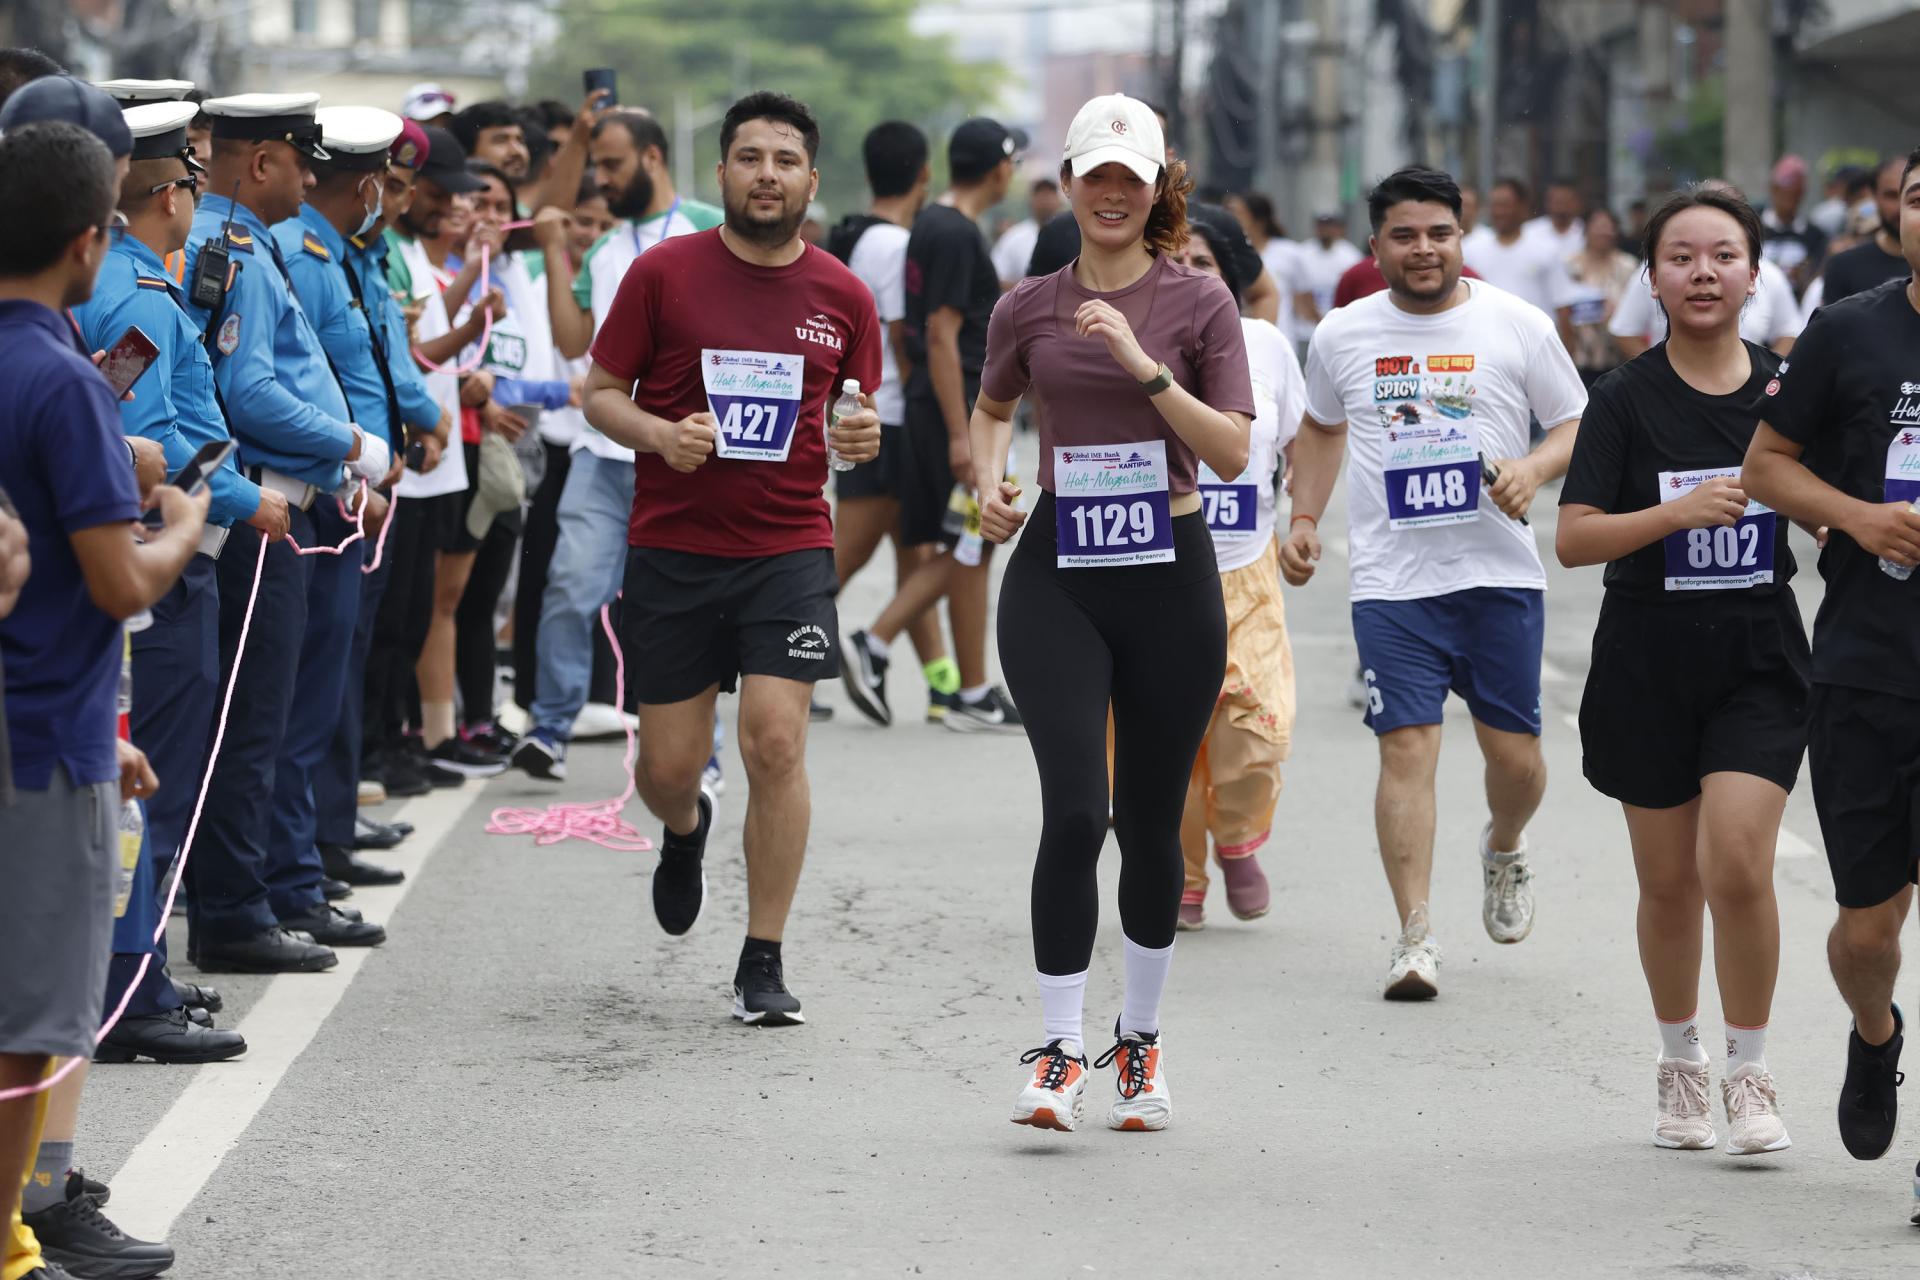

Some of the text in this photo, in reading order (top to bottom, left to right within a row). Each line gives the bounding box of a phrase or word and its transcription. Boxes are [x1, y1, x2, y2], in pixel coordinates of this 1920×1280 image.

[806, 319, 827, 329] Nepal
[795, 327, 841, 350] ULTRA
[1376, 356, 1413, 377] HOT
[1375, 380, 1418, 400] SPICY
[721, 402, 779, 442] 427
[1119, 461, 1151, 469] KANTIPUR
[1405, 469, 1467, 510] 448
[1682, 475, 1703, 483] Global
[1199, 490, 1239, 526] 75
[1071, 501, 1155, 547] 1129
[1687, 523, 1759, 569] 802
[1067, 552, 1166, 565] #runforgreenertomorrow #greenrun
[1674, 578, 1747, 586] #runforgreenertomorrow
[1364, 668, 1384, 716] 6
